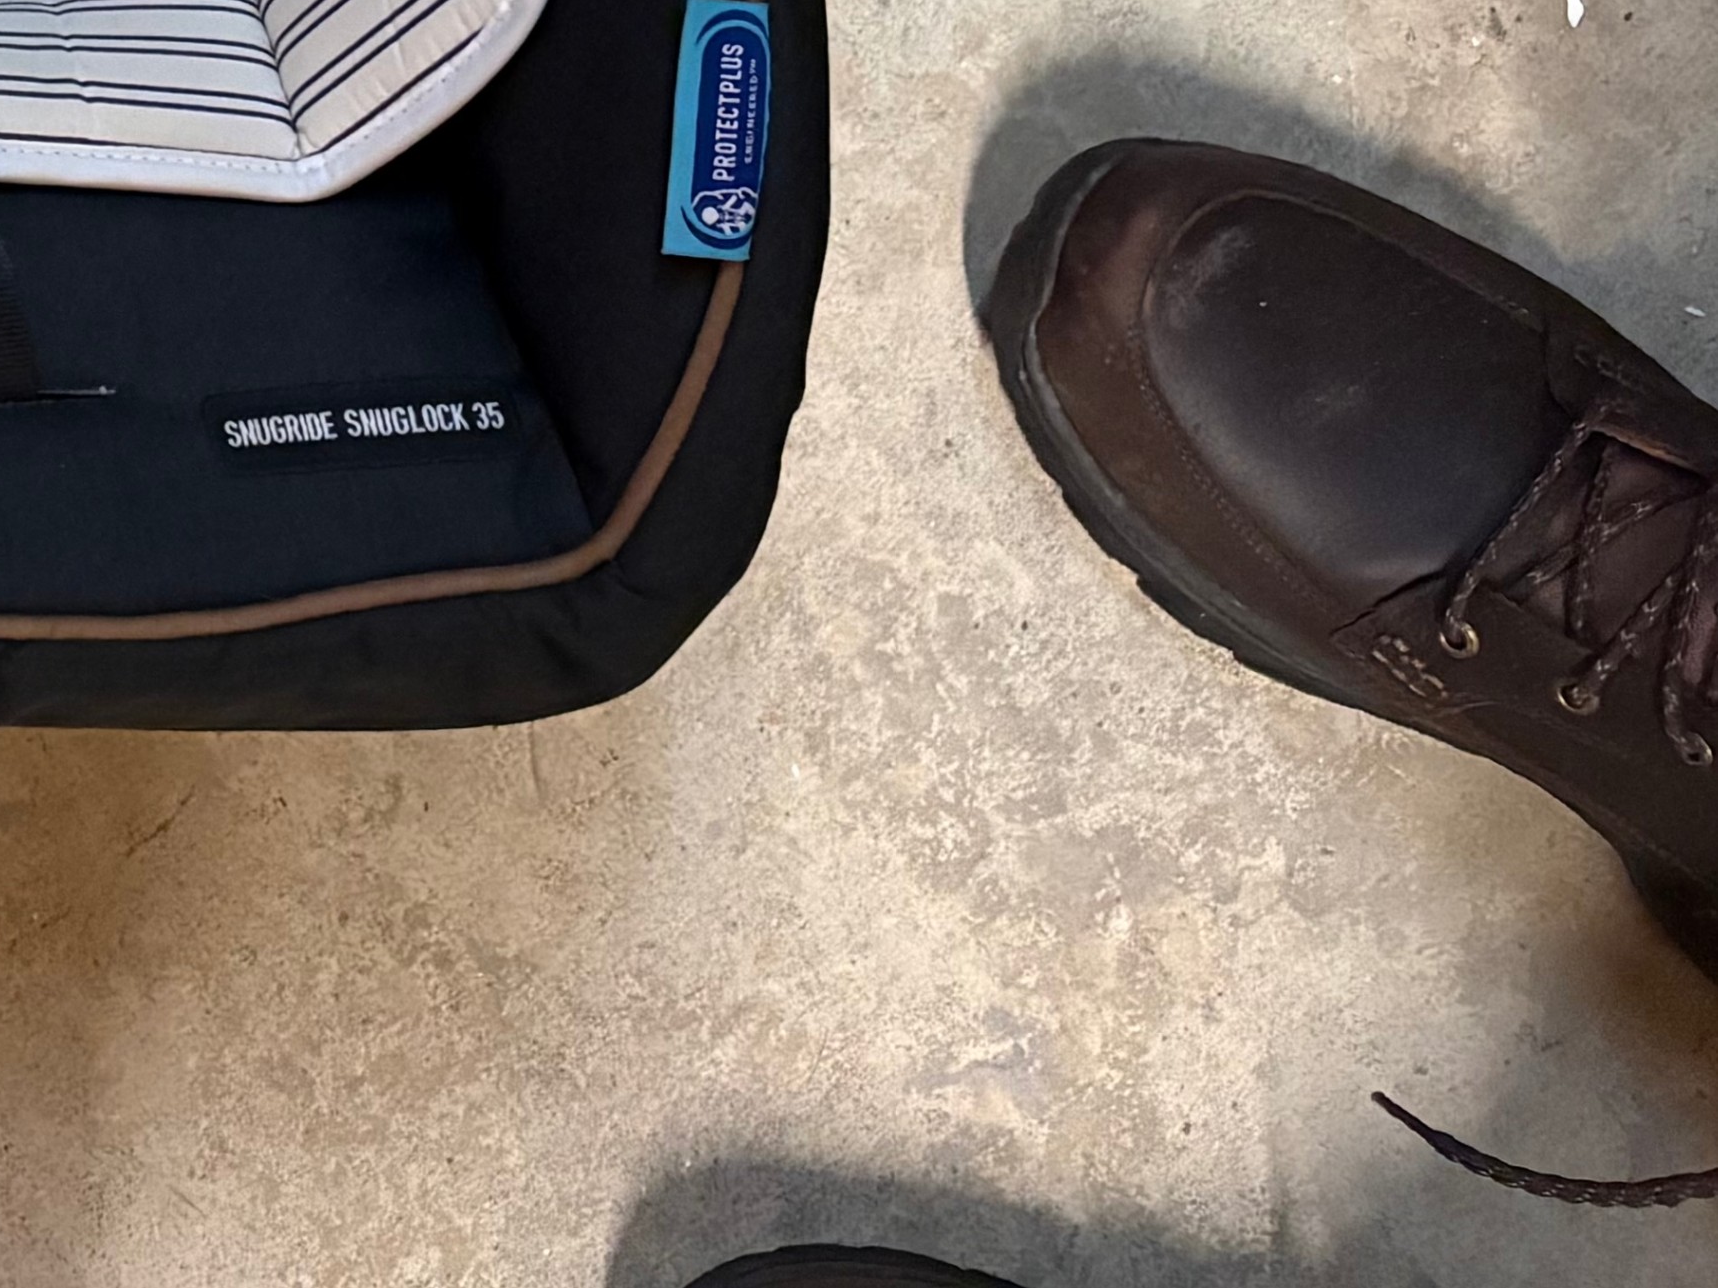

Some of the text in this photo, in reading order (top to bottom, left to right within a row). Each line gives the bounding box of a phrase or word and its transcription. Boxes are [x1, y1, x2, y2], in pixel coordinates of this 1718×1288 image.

[712, 41, 743, 183] PROTECTPLUS
[224, 402, 505, 449] SNUGRIDE SNUGLOCK 35
